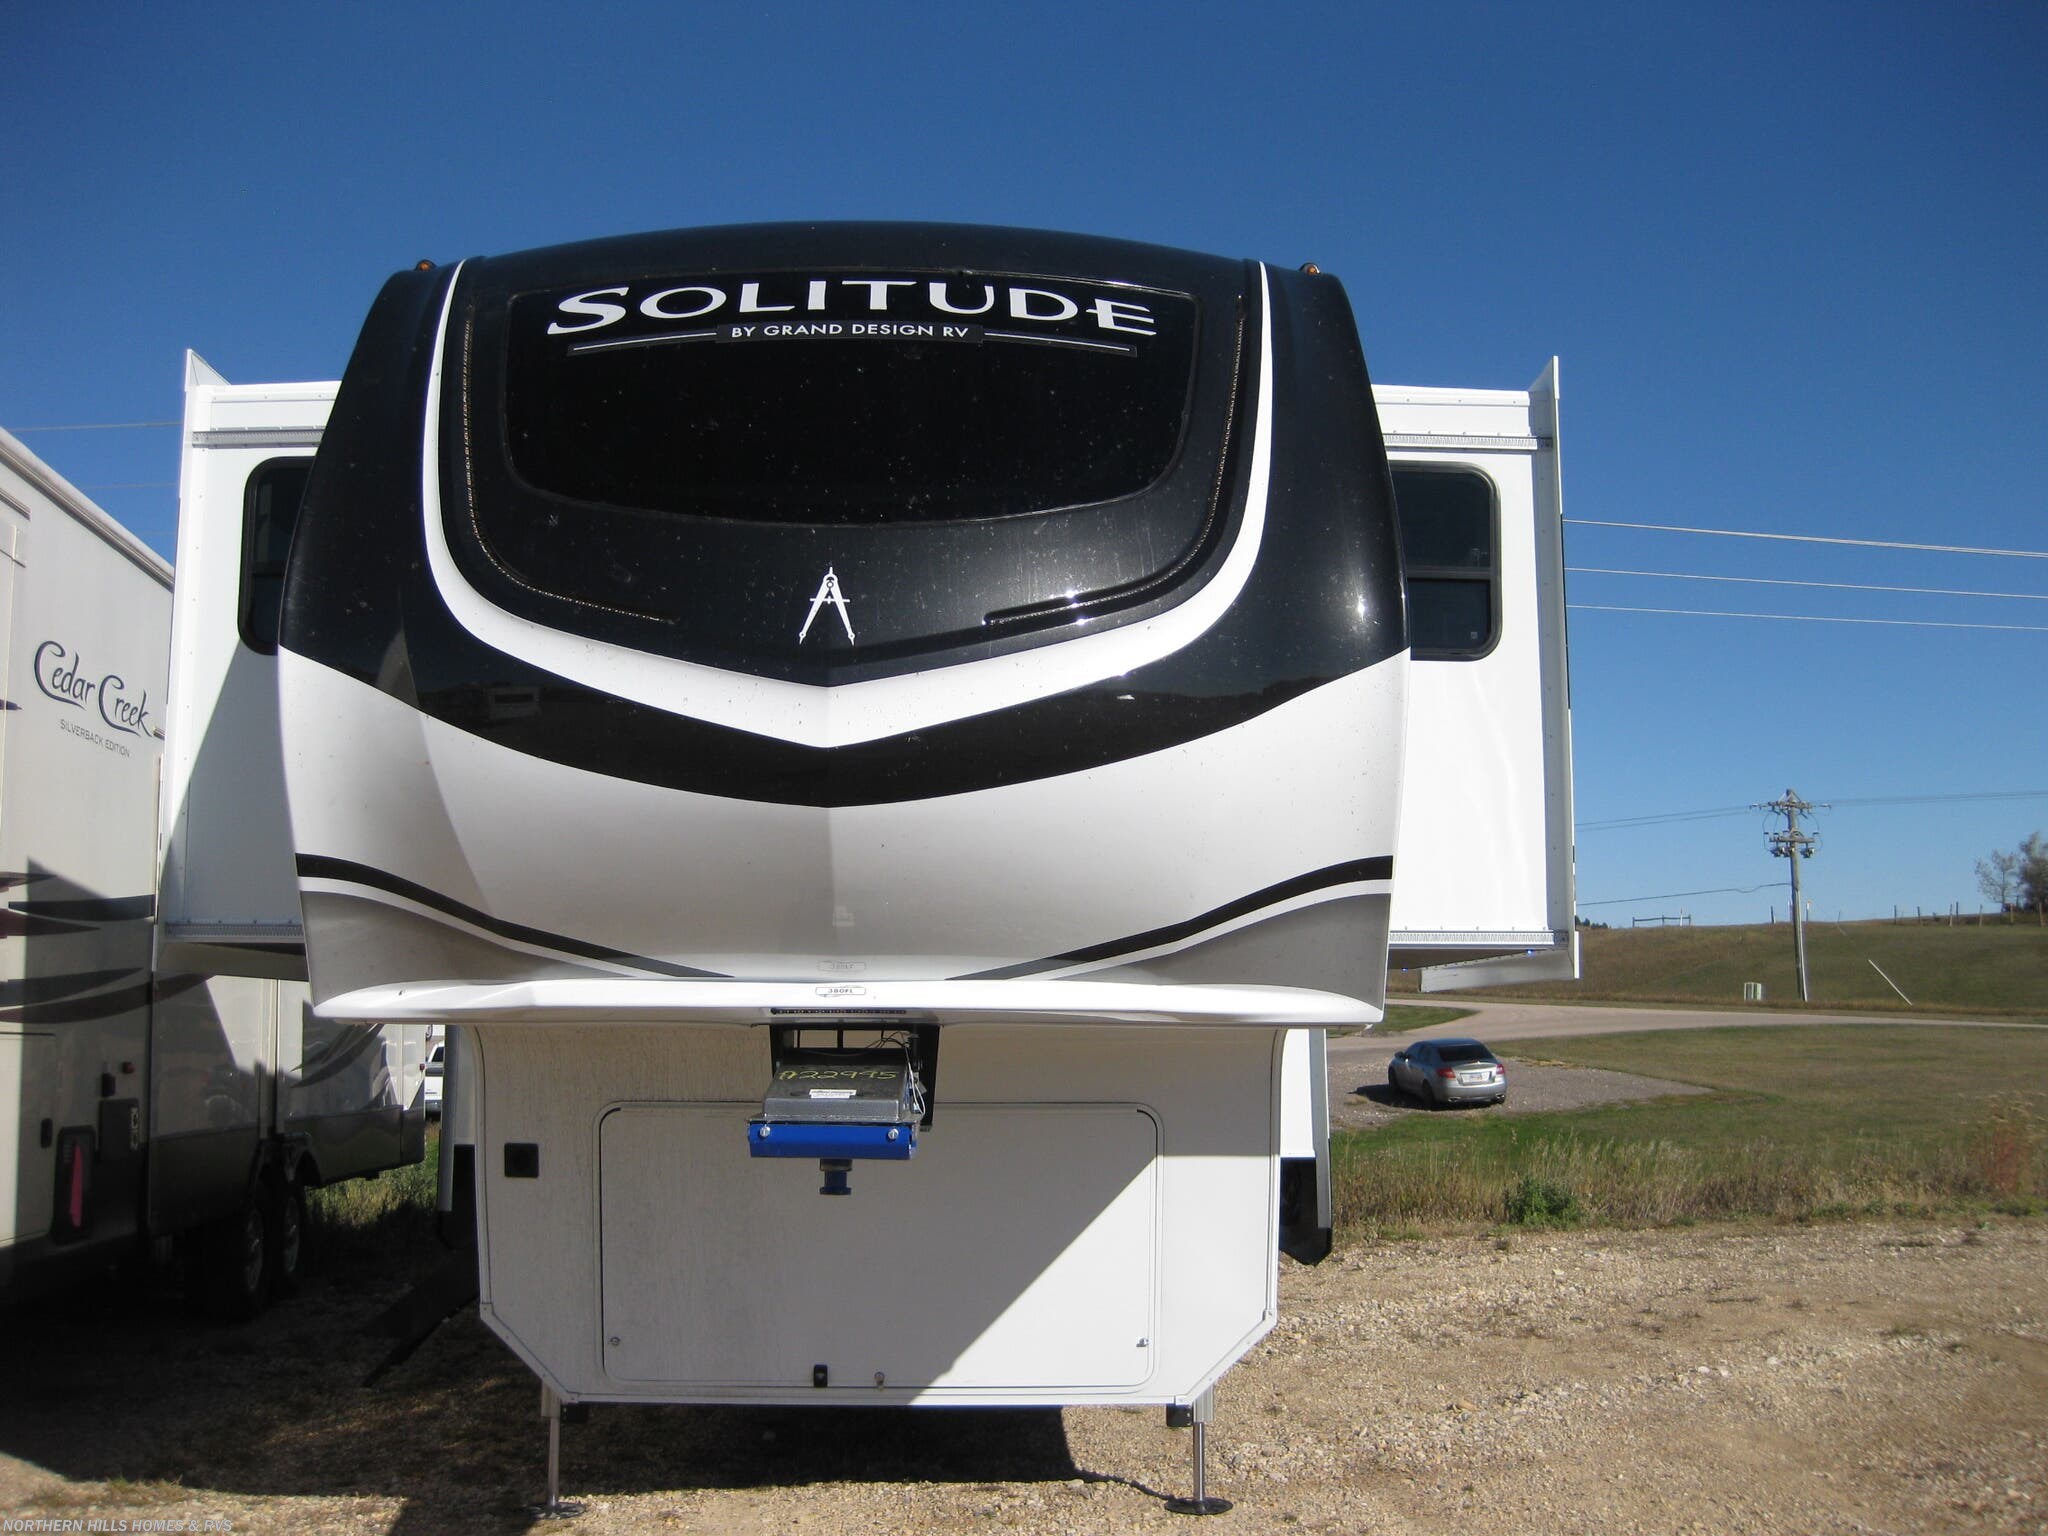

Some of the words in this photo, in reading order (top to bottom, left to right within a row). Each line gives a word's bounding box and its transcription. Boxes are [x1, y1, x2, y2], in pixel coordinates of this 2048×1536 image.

[547, 280, 1157, 336] SOLITUDE
[731, 326, 756, 338] BY
[764, 324, 843, 336] GRAND
[852, 324, 934, 336] DESIGN
[943, 326, 969, 338] RV
[34, 640, 96, 711] Cedar
[98, 674, 153, 738] Creek
[60, 718, 104, 748] SILVERBACK
[105, 739, 131, 758] EDITION
